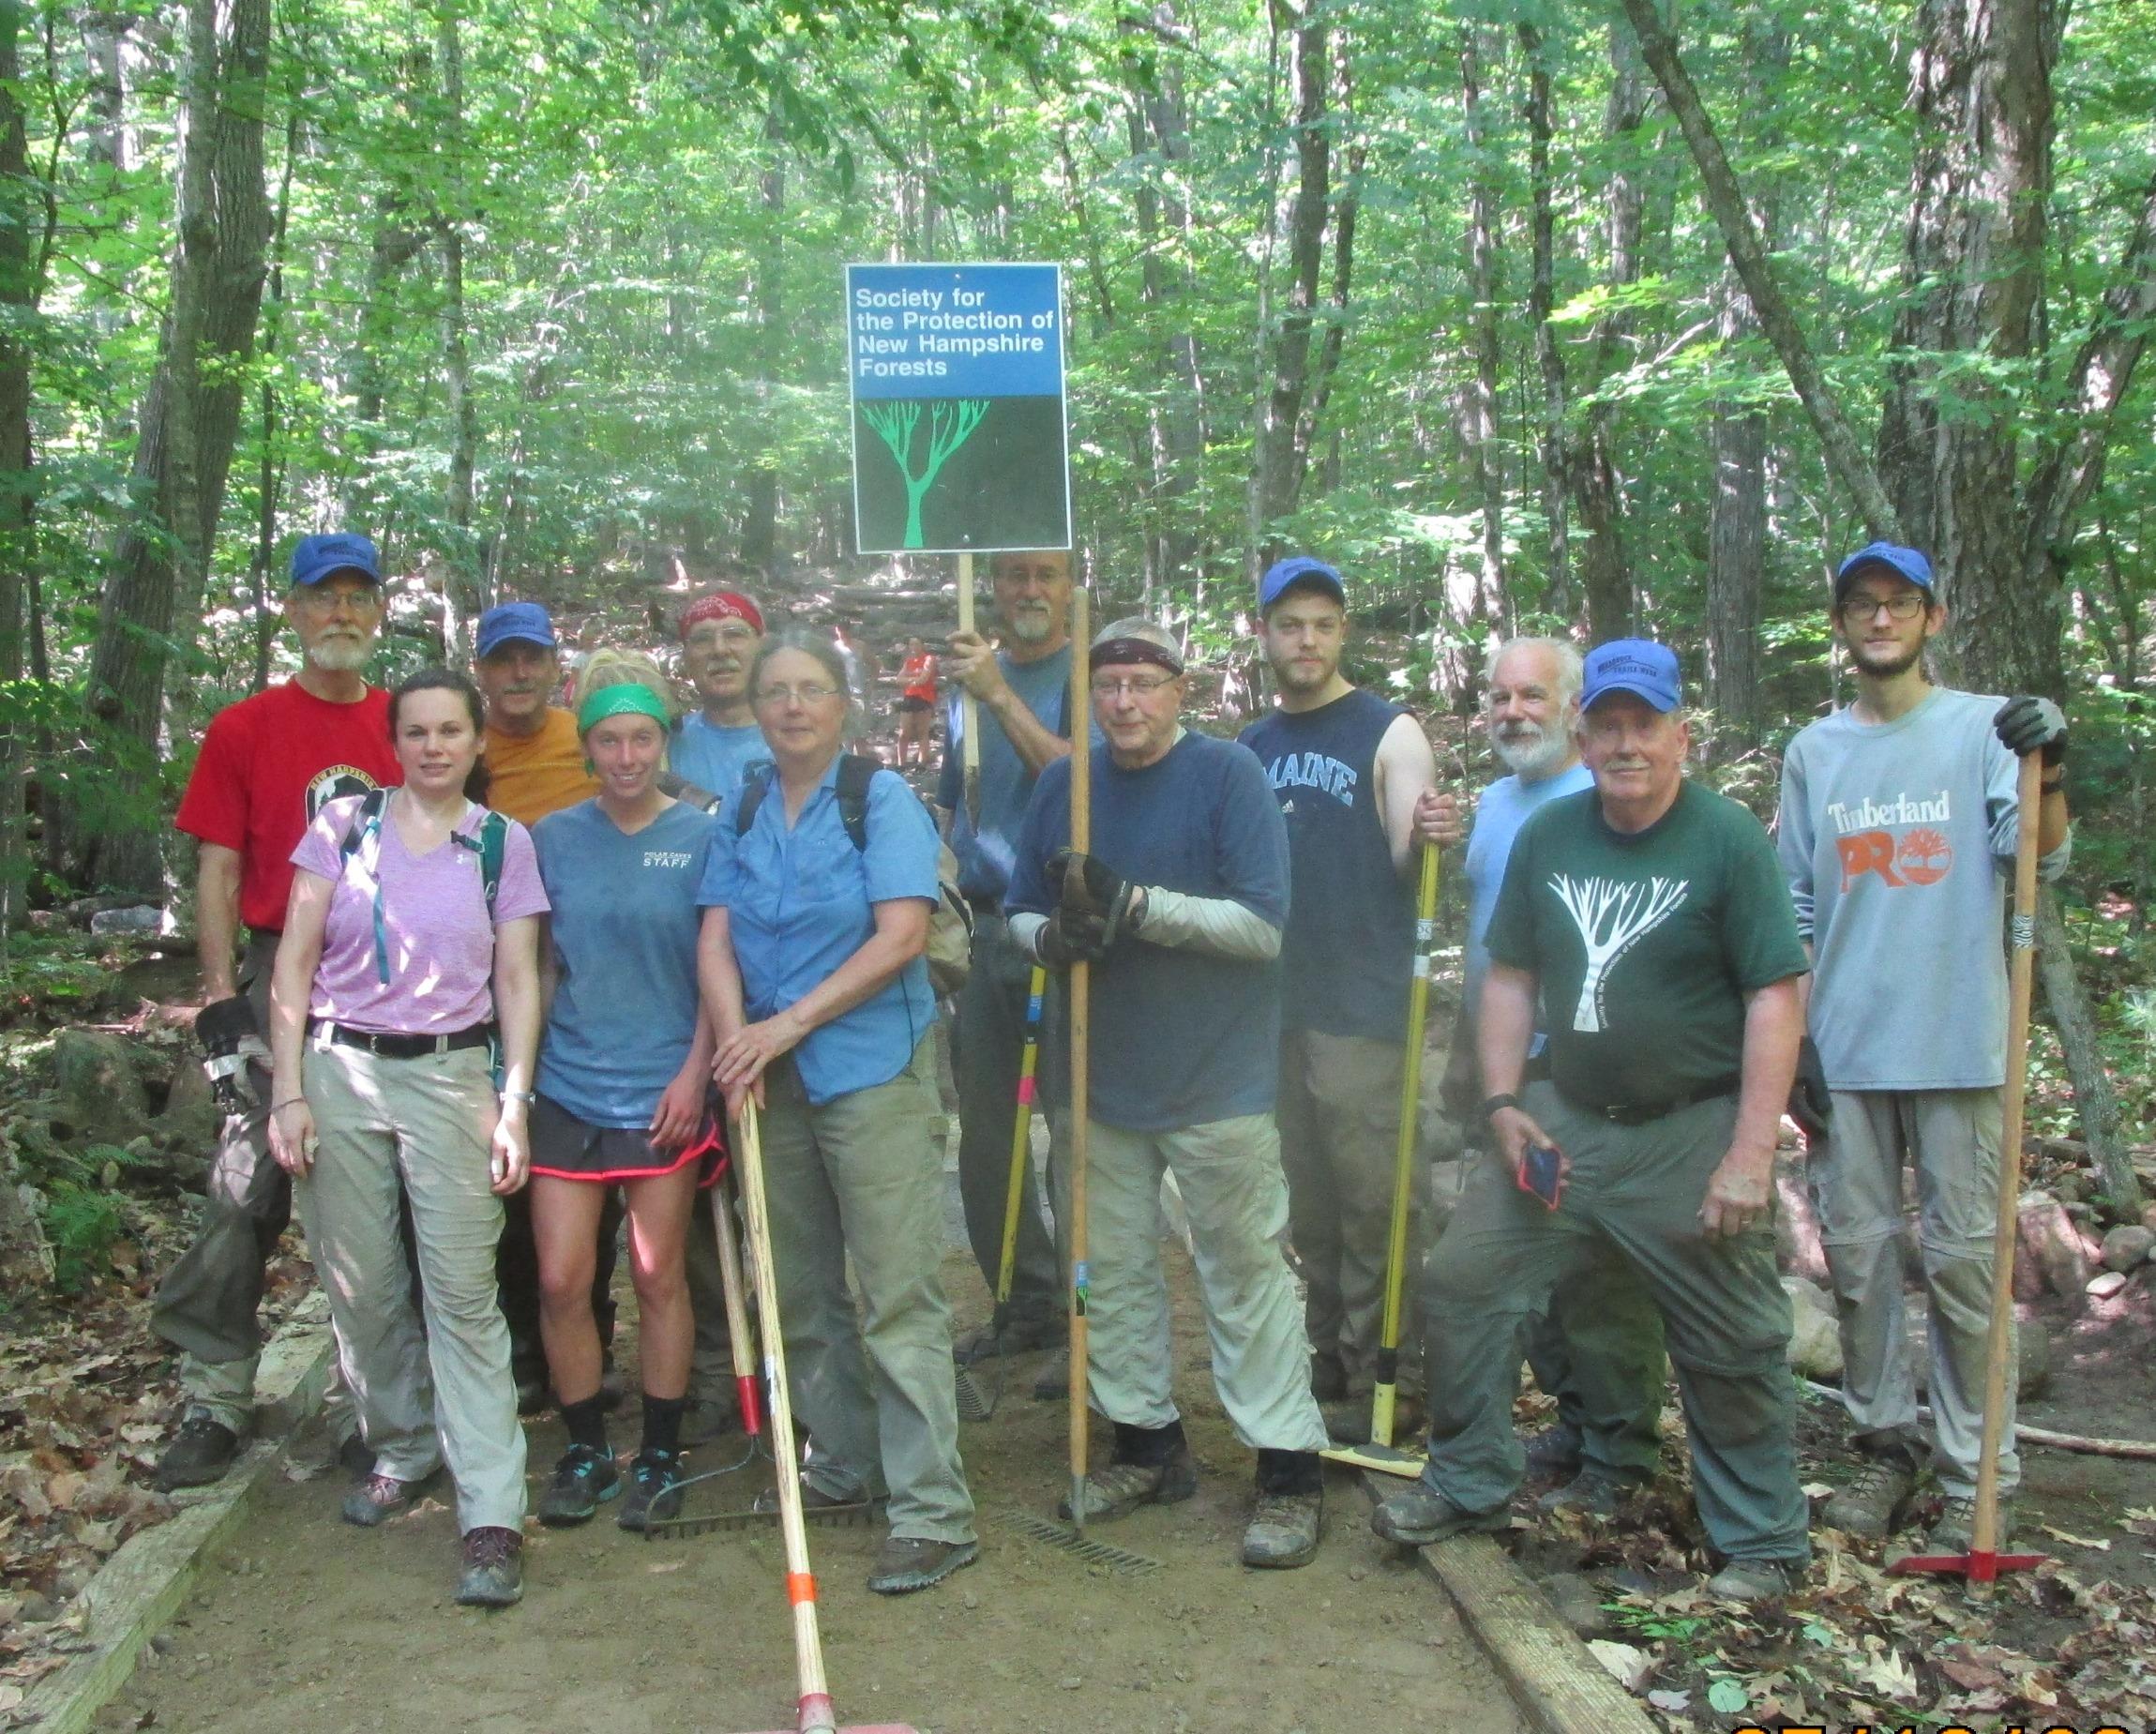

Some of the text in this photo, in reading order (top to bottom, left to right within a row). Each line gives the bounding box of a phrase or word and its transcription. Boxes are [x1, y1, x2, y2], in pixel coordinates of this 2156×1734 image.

[855, 287, 985, 311] Society for
[856, 310, 1053, 330] the Protection of
[858, 333, 1044, 357] New Hampshire
[859, 358, 947, 376] Forests
[310, 765, 376, 791] NEW HAMPSHIR
[1828, 790, 1951, 833] Timberland
[643, 857, 689, 868] STAFF
[1621, 944, 1629, 953] of
